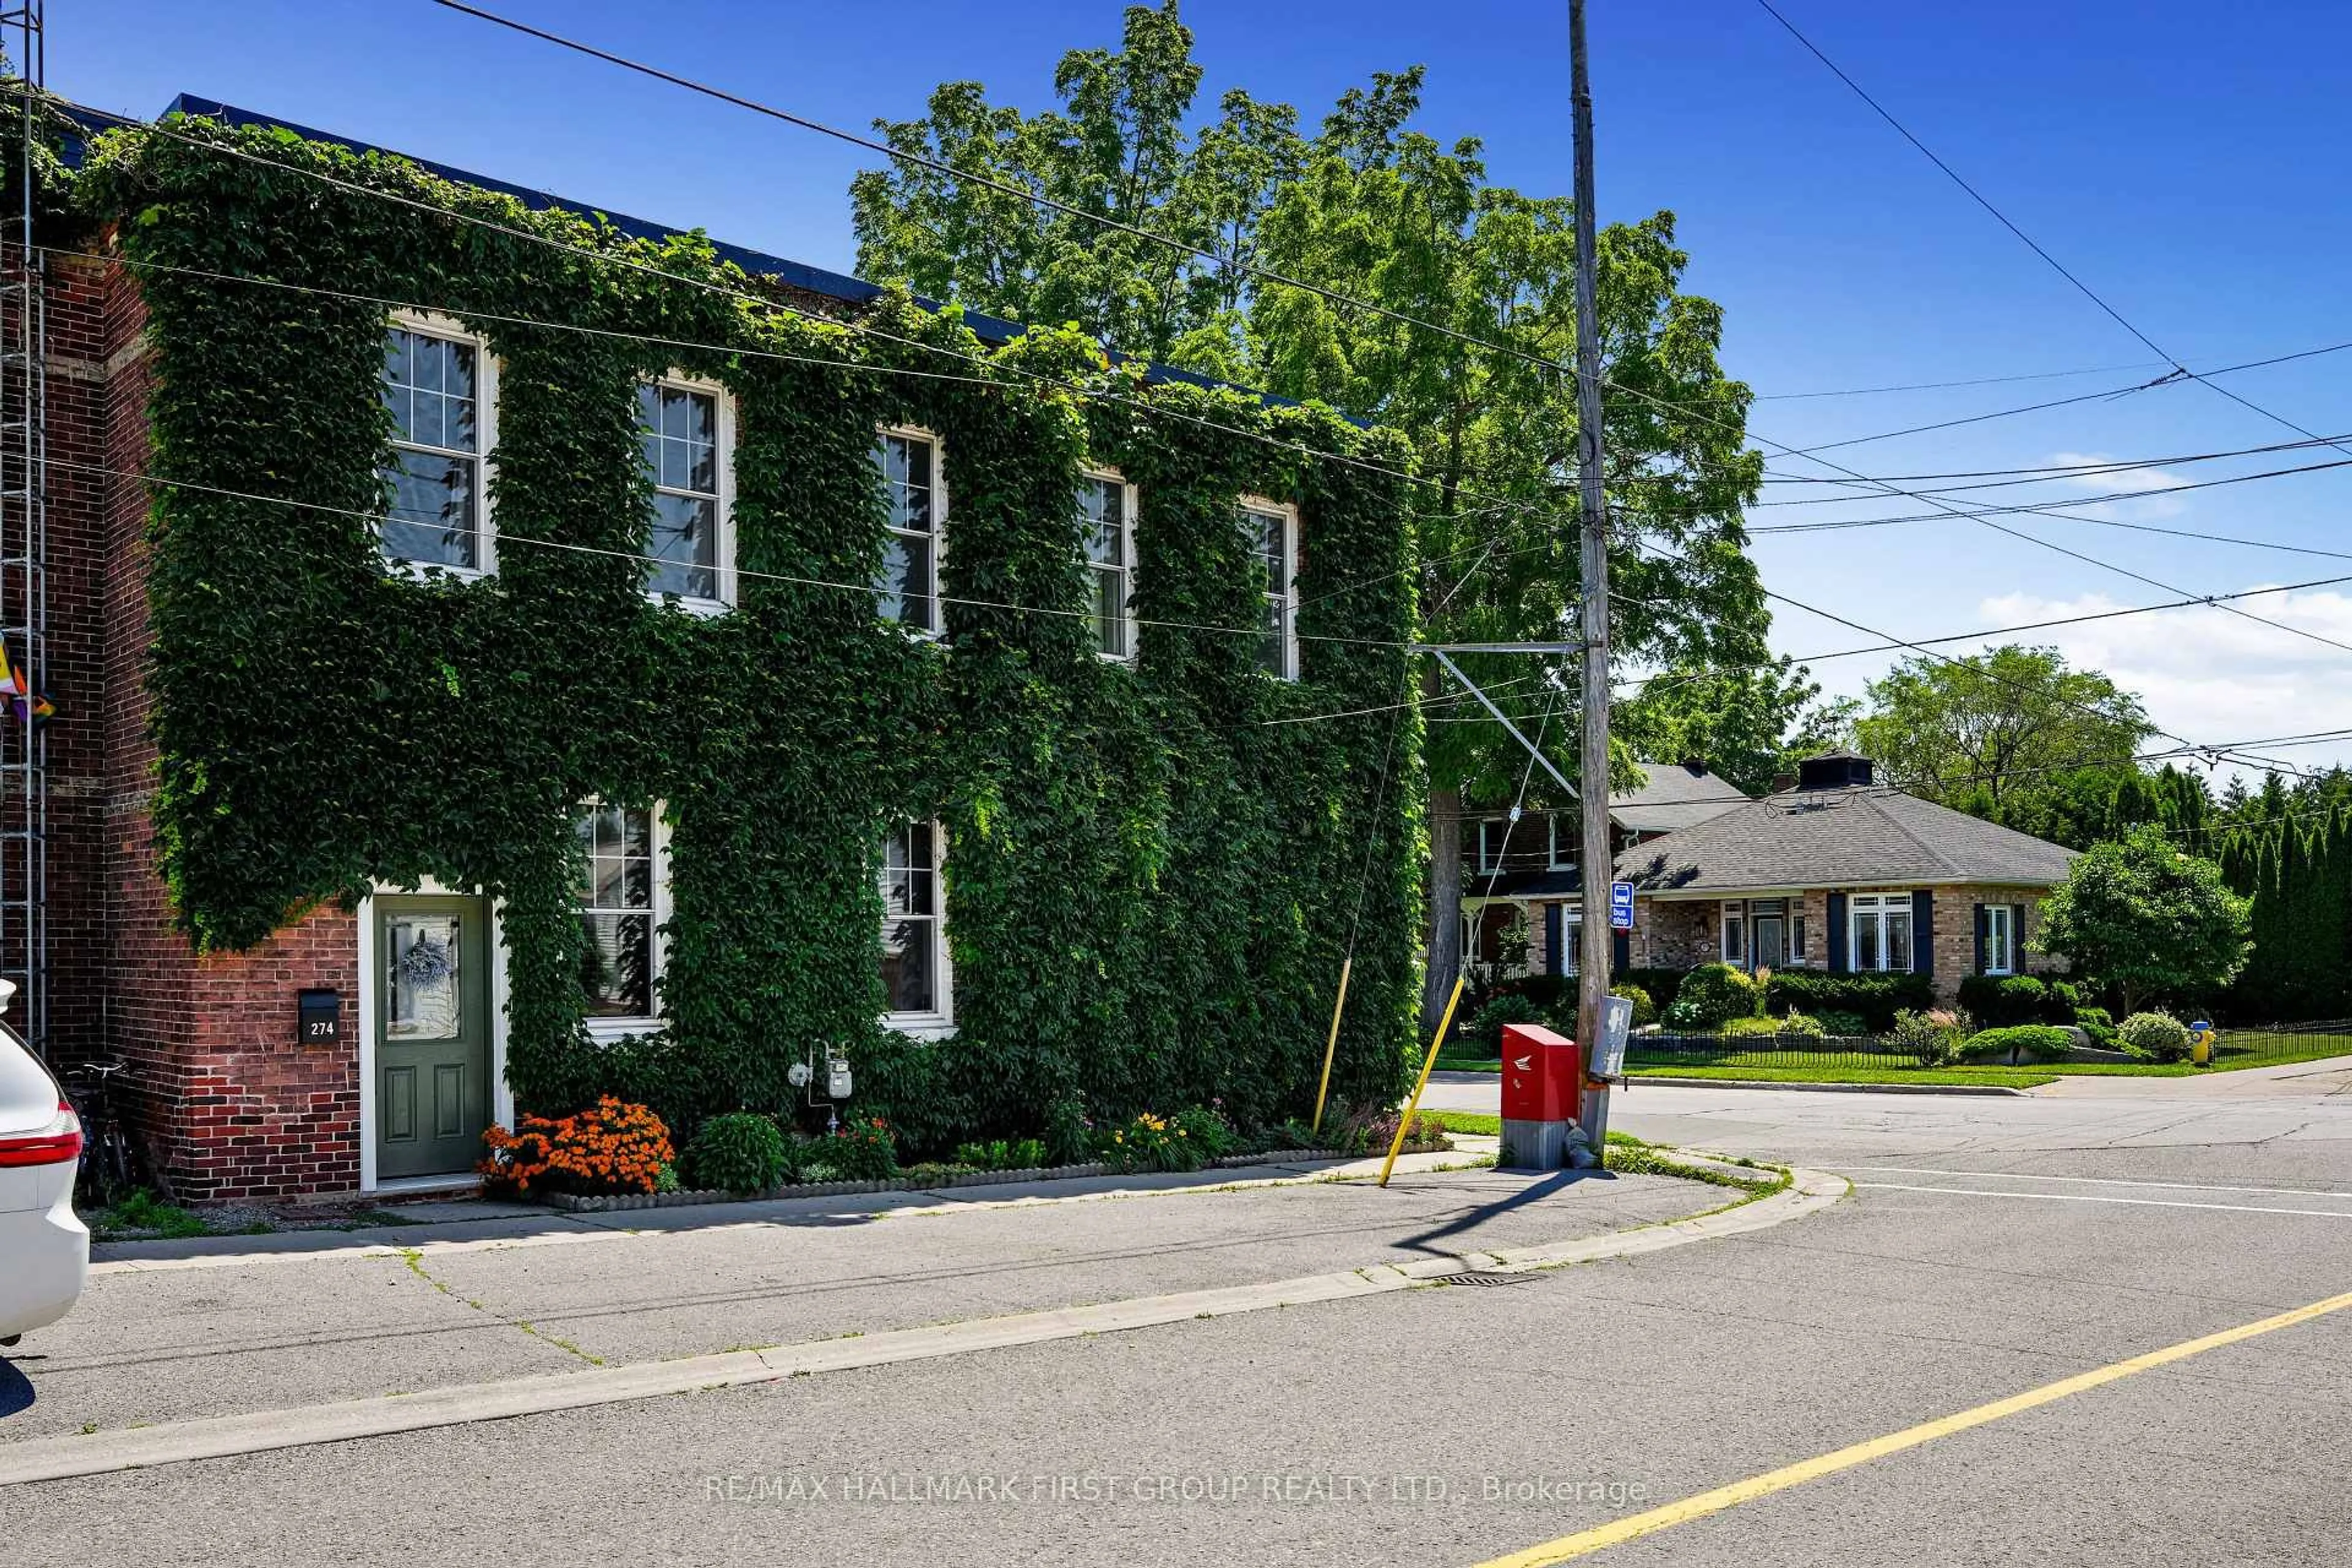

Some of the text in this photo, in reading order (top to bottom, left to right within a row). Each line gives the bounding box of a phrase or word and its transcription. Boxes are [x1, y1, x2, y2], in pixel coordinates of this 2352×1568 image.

[1613, 908, 1626, 916] bus
[1613, 917, 1629, 925] stop
[311, 1022, 334, 1035] 274
